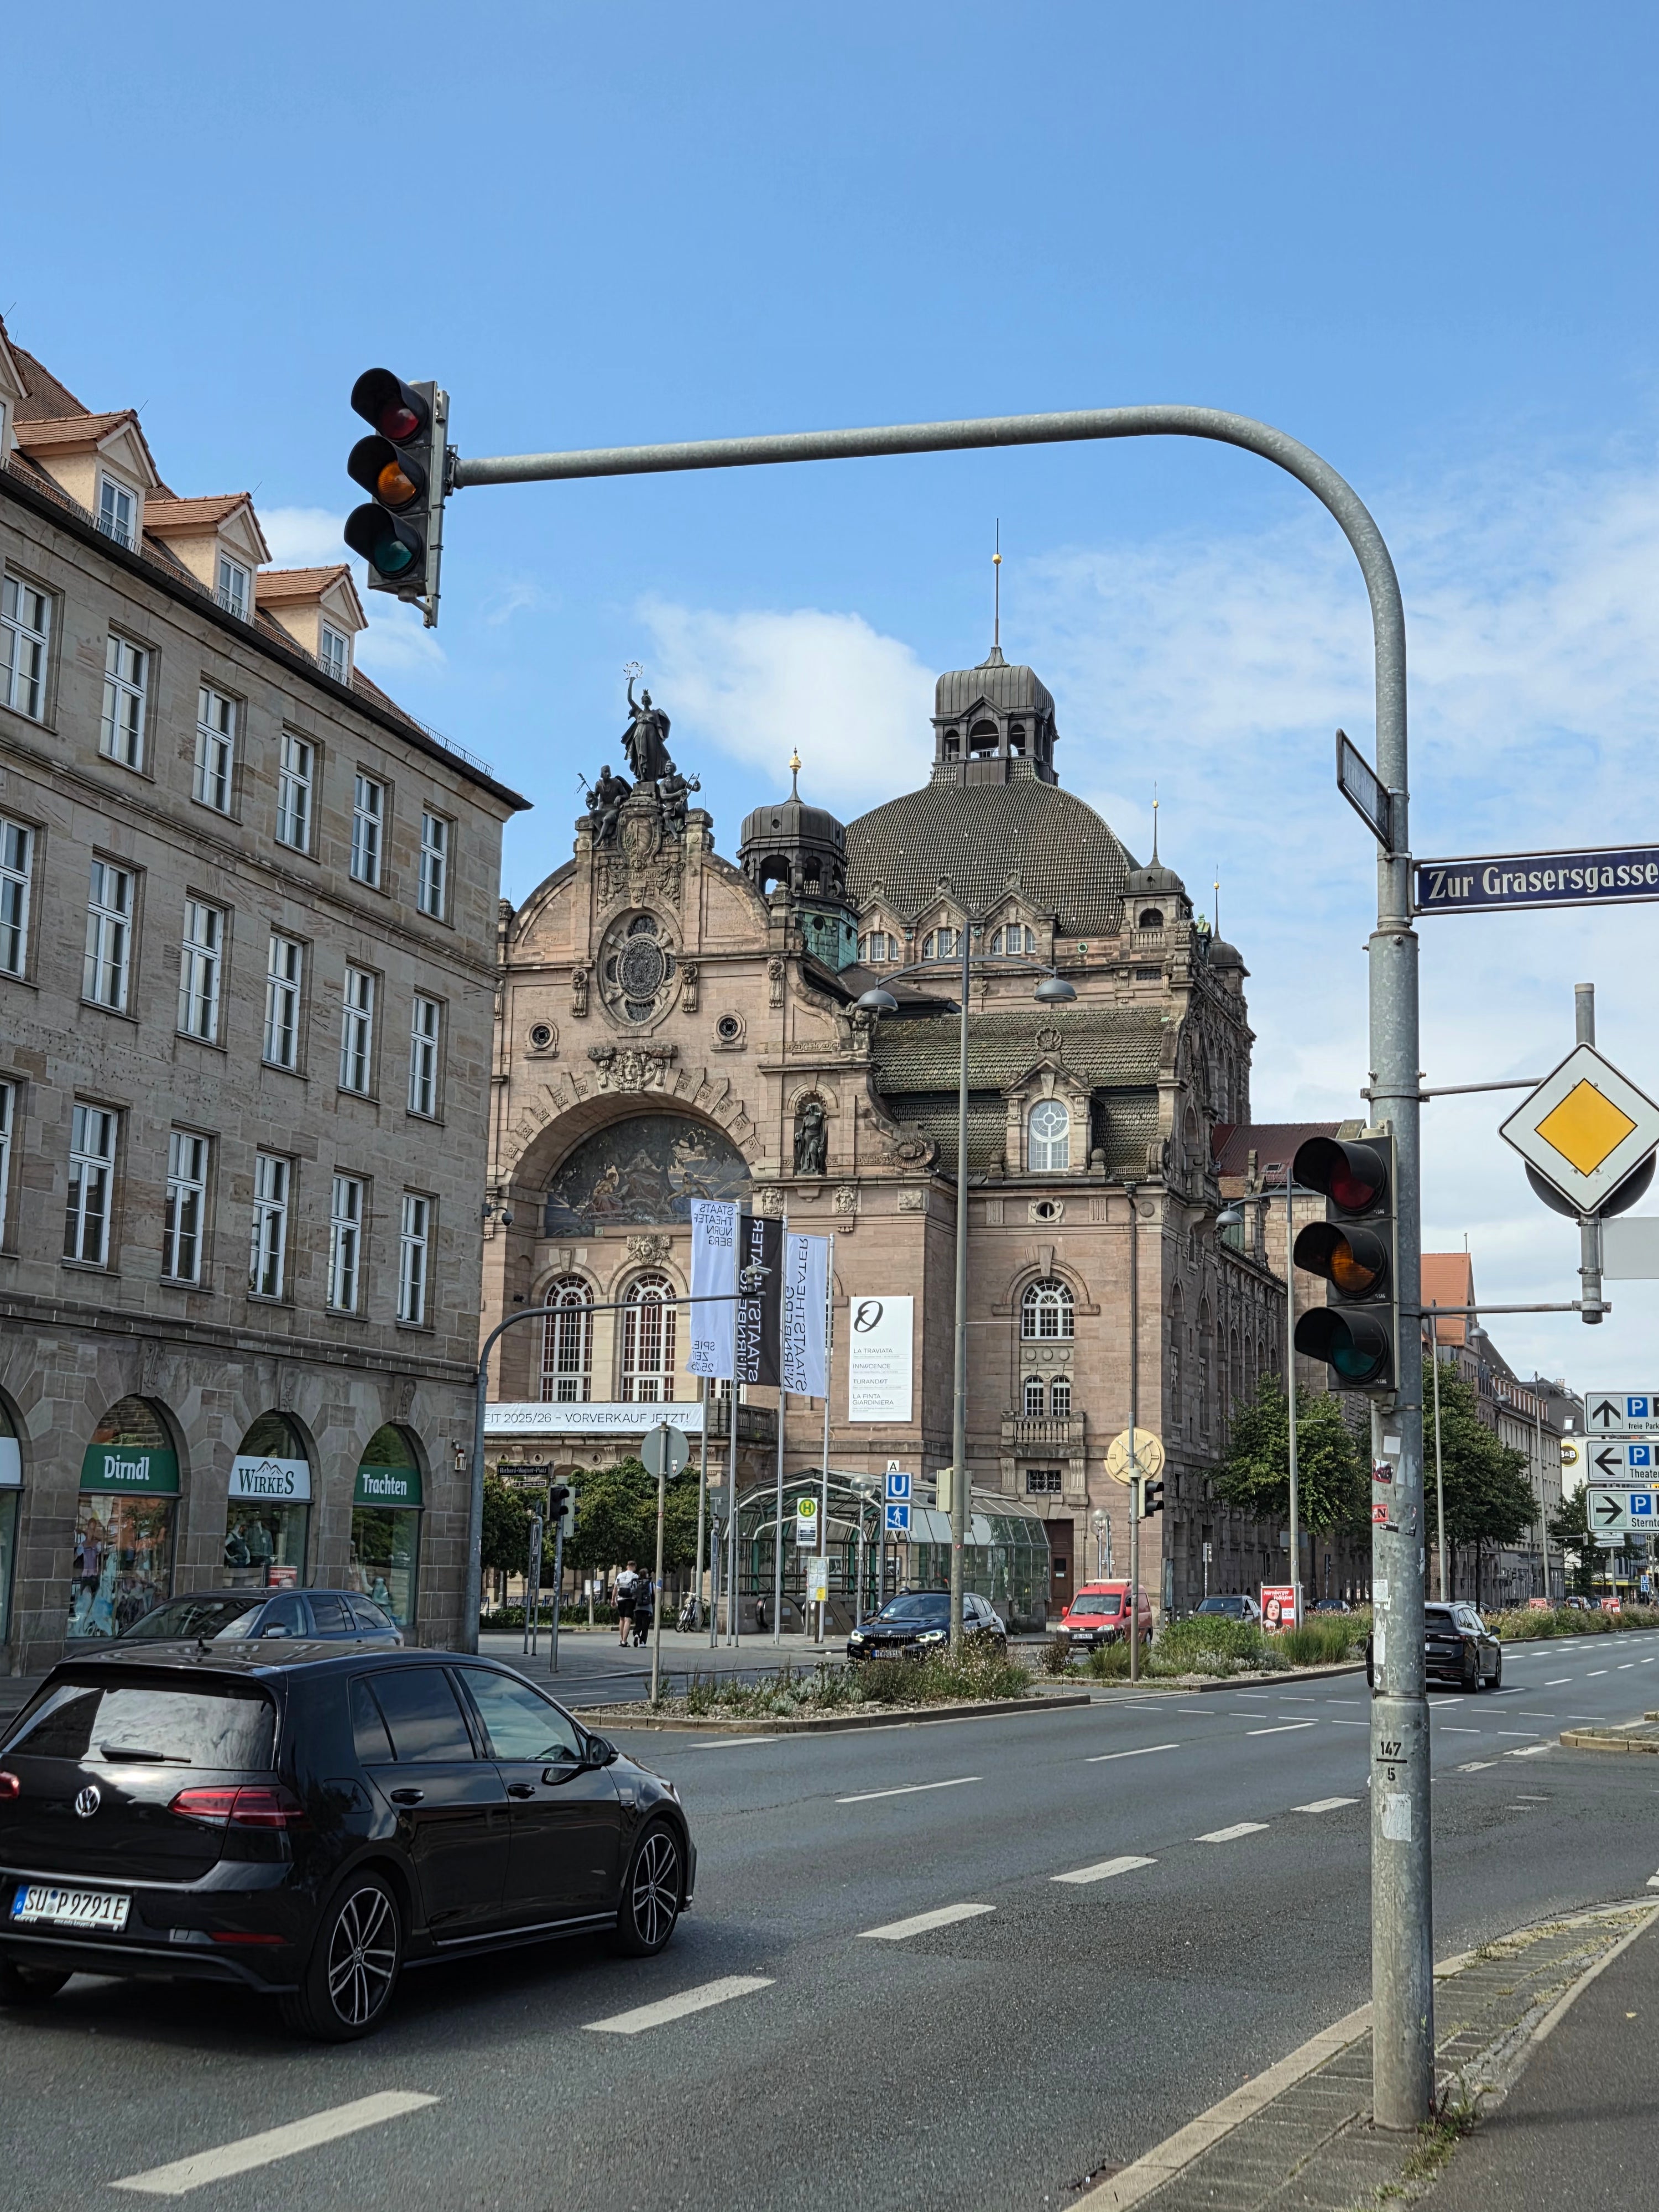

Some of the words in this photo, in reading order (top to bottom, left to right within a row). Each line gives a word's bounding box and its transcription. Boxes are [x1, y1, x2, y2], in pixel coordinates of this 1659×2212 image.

[1429, 870, 1473, 899] Zur
[1483, 862, 1658, 895] Grasersgasse
[1631, 1399, 1644, 1415] P
[504, 1413, 551, 1424] 2025/26
[565, 1413, 647, 1423] VORVERKAUF
[650, 1413, 688, 1423] JETZT!
[1634, 1448, 1645, 1464] P
[104, 1455, 150, 1480] Dirndl
[889, 1462, 897, 1471] A
[1630, 1468, 1659, 1478] Theate
[239, 1468, 294, 1494] WIRKES
[363, 1474, 407, 1495] Trachten
[891, 1476, 906, 1495] U
[1635, 1496, 1647, 1512] P
[1380, 1741, 1401, 1756] 147
[1387, 1767, 1396, 1781] 5
[25, 1889, 48, 1912] SU
